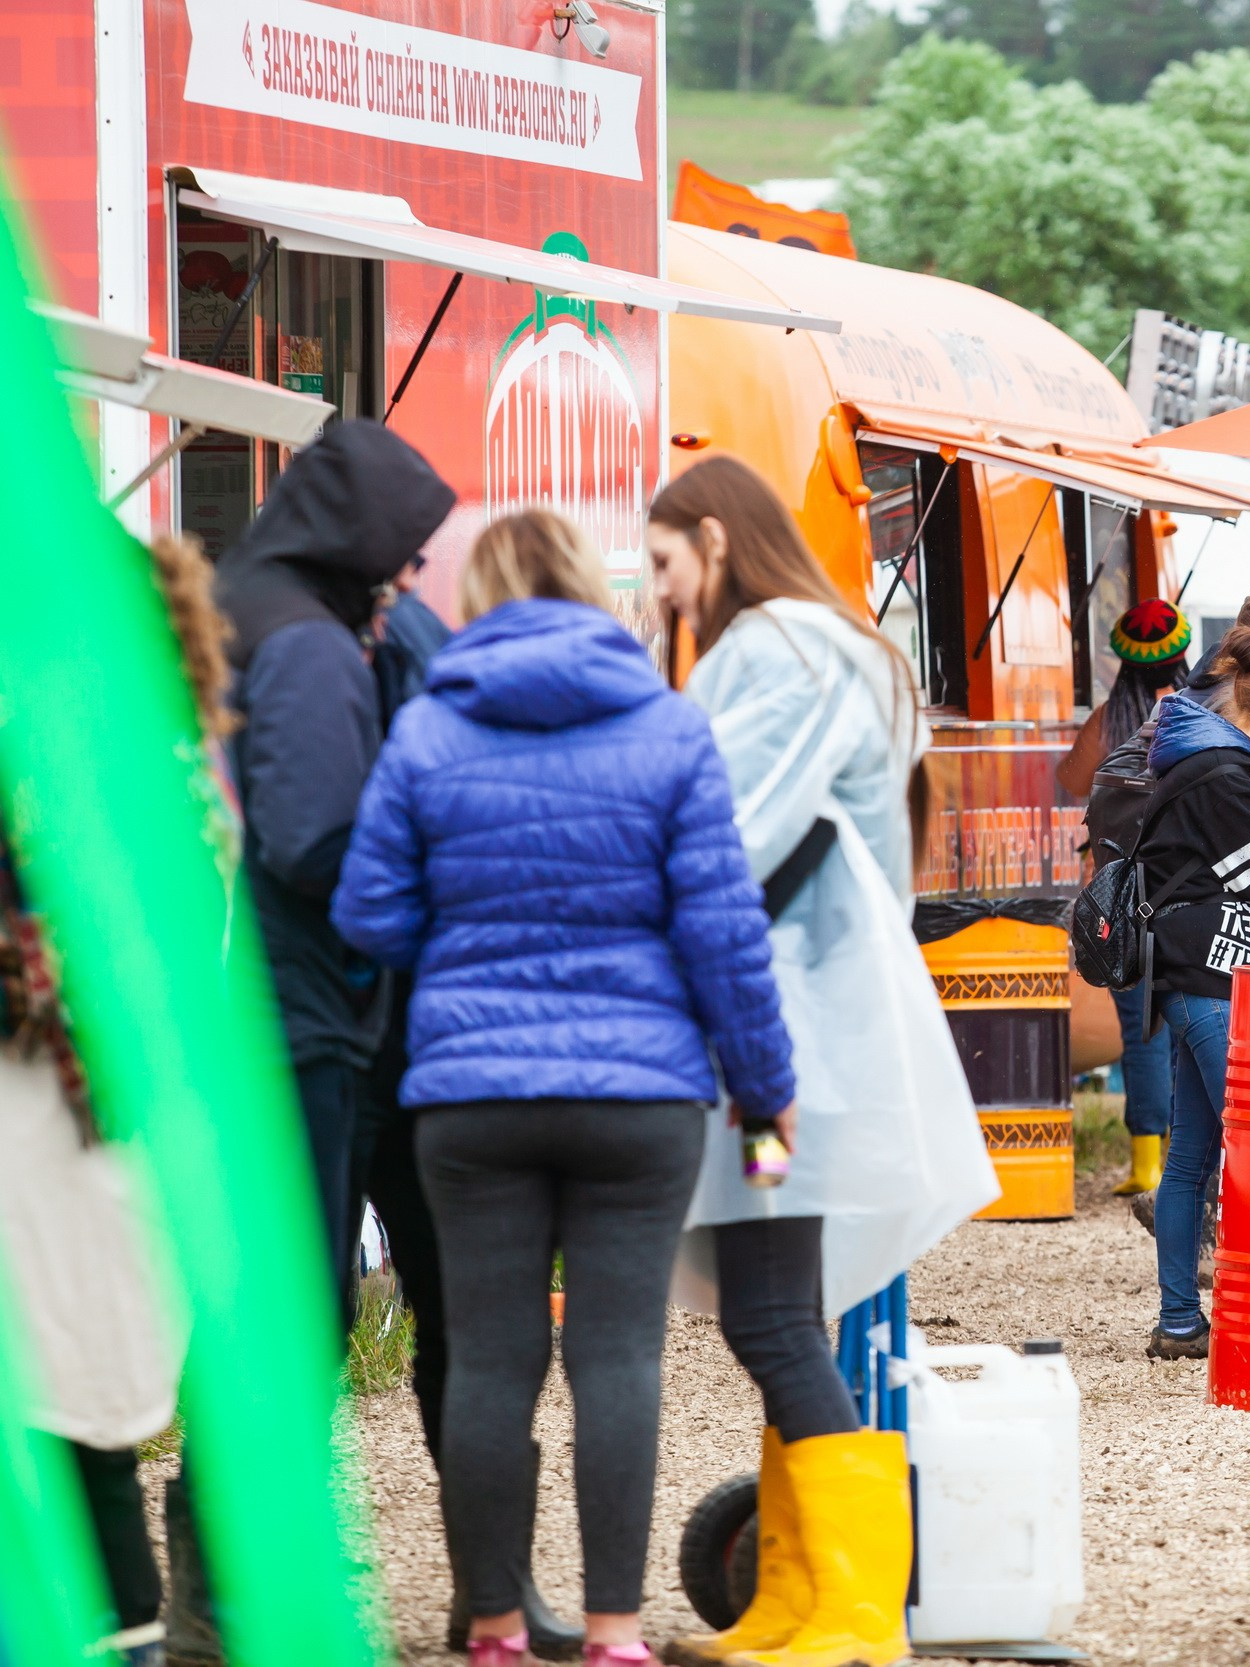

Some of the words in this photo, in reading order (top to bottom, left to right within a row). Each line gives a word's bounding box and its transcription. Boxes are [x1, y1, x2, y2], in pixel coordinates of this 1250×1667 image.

[261, 23, 361, 109] ЗАКАЗЫВАЙ
[365, 42, 426, 121] ОНЛАЙН
[429, 61, 450, 125] НА
[452, 65, 587, 149] WWW.PAPAJOHNS.RU
[488, 354, 553, 520] ПАПА
